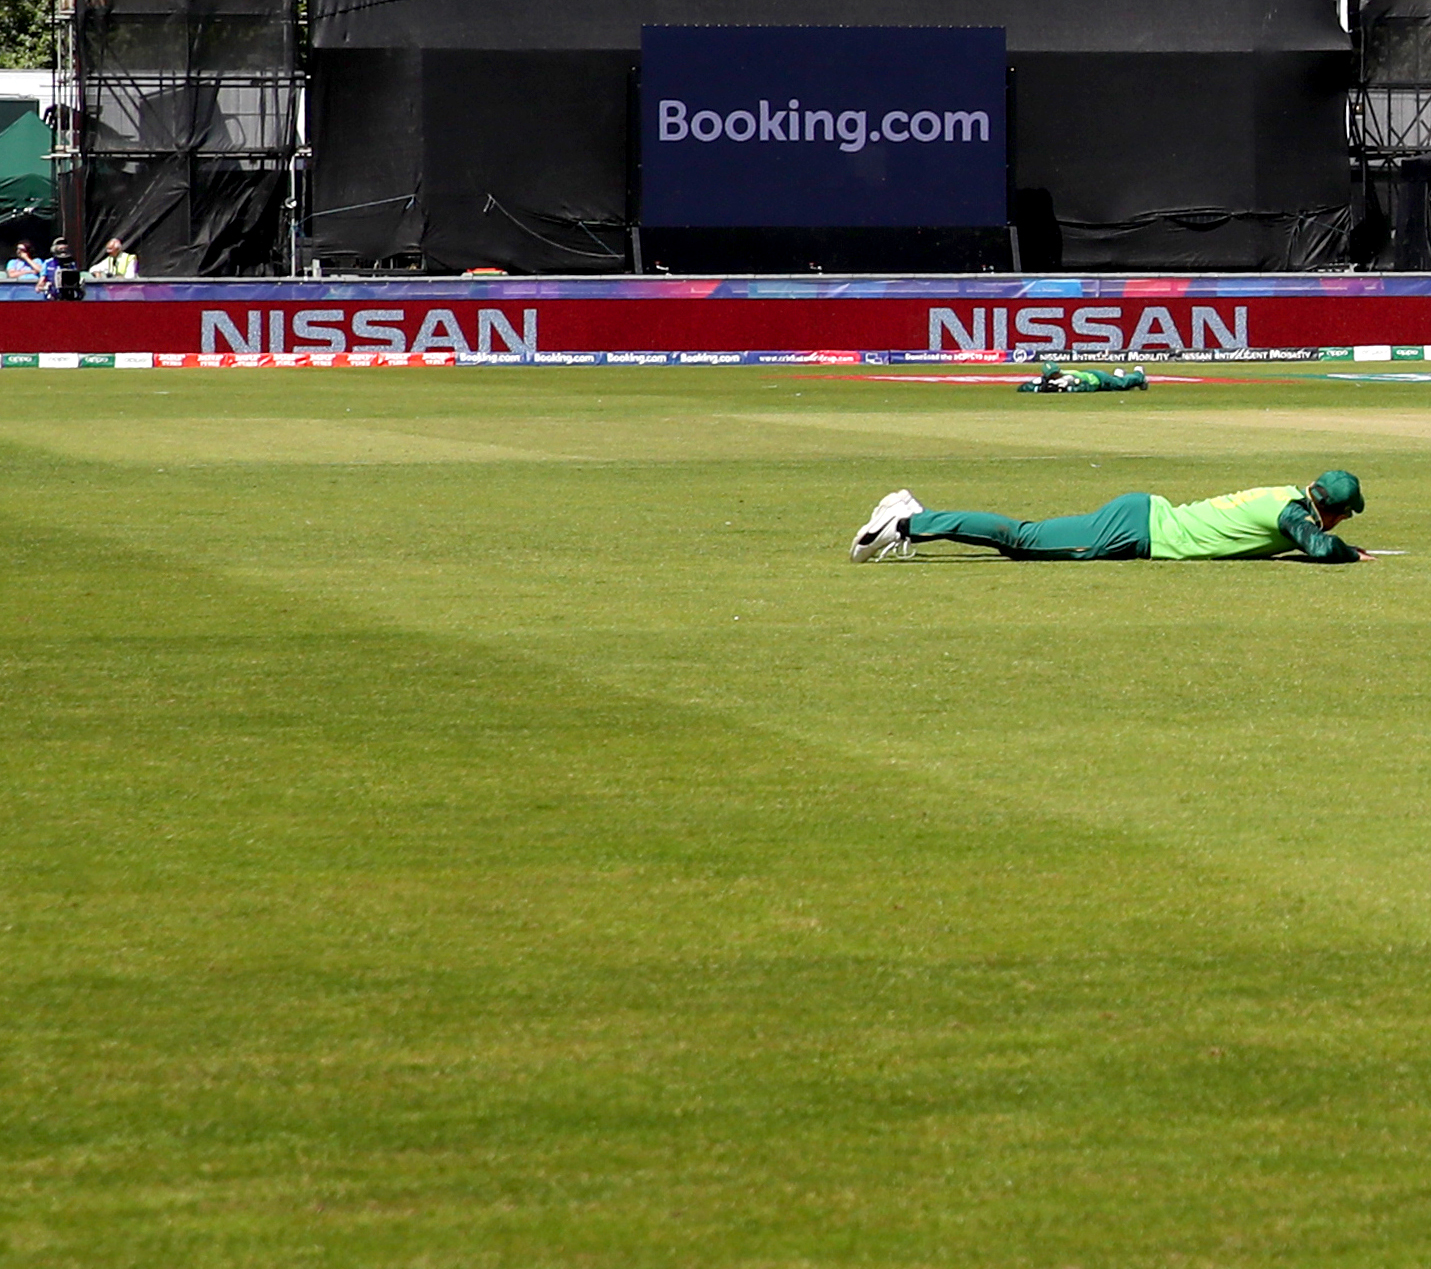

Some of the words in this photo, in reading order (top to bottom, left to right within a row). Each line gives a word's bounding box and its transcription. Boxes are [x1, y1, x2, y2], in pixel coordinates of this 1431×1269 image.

[657, 97, 990, 154] Booking.com
[200, 308, 537, 353] NISSAN
[928, 306, 1248, 350] NISSAN
[533, 353, 595, 366] Booking.com
[606, 353, 667, 366] Booking.com
[679, 353, 740, 365] Booking.com
